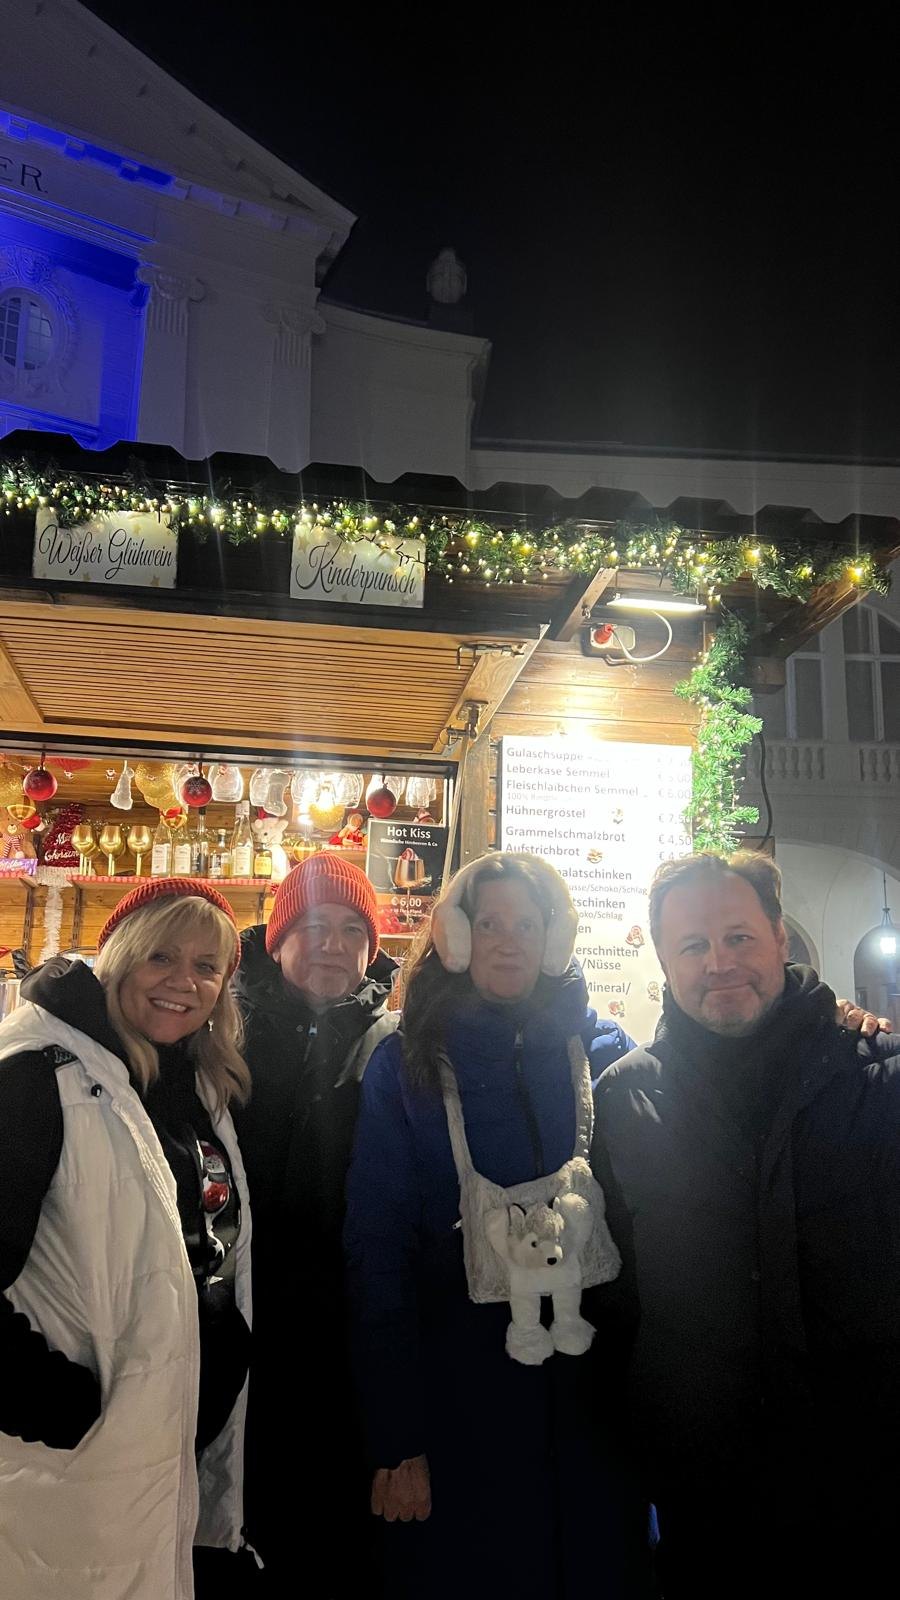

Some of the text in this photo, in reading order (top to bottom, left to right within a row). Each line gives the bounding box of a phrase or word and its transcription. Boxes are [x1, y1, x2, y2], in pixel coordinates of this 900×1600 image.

[38, 524, 173, 580] Weißer Glühwein
[295, 541, 417, 602] Kinderpunsch
[506, 747, 584, 761] Gulaschsuppe
[566, 766, 611, 778] Semmel
[506, 780, 591, 793] Fleischlaibchen
[594, 782, 639, 796] Semmel
[387, 826, 431, 839] Hot Kiss
[505, 826, 626, 842] Grammelschmalzbrot
[658, 834, 665, 845] €
[505, 843, 580, 857] Aufstrichbrot
